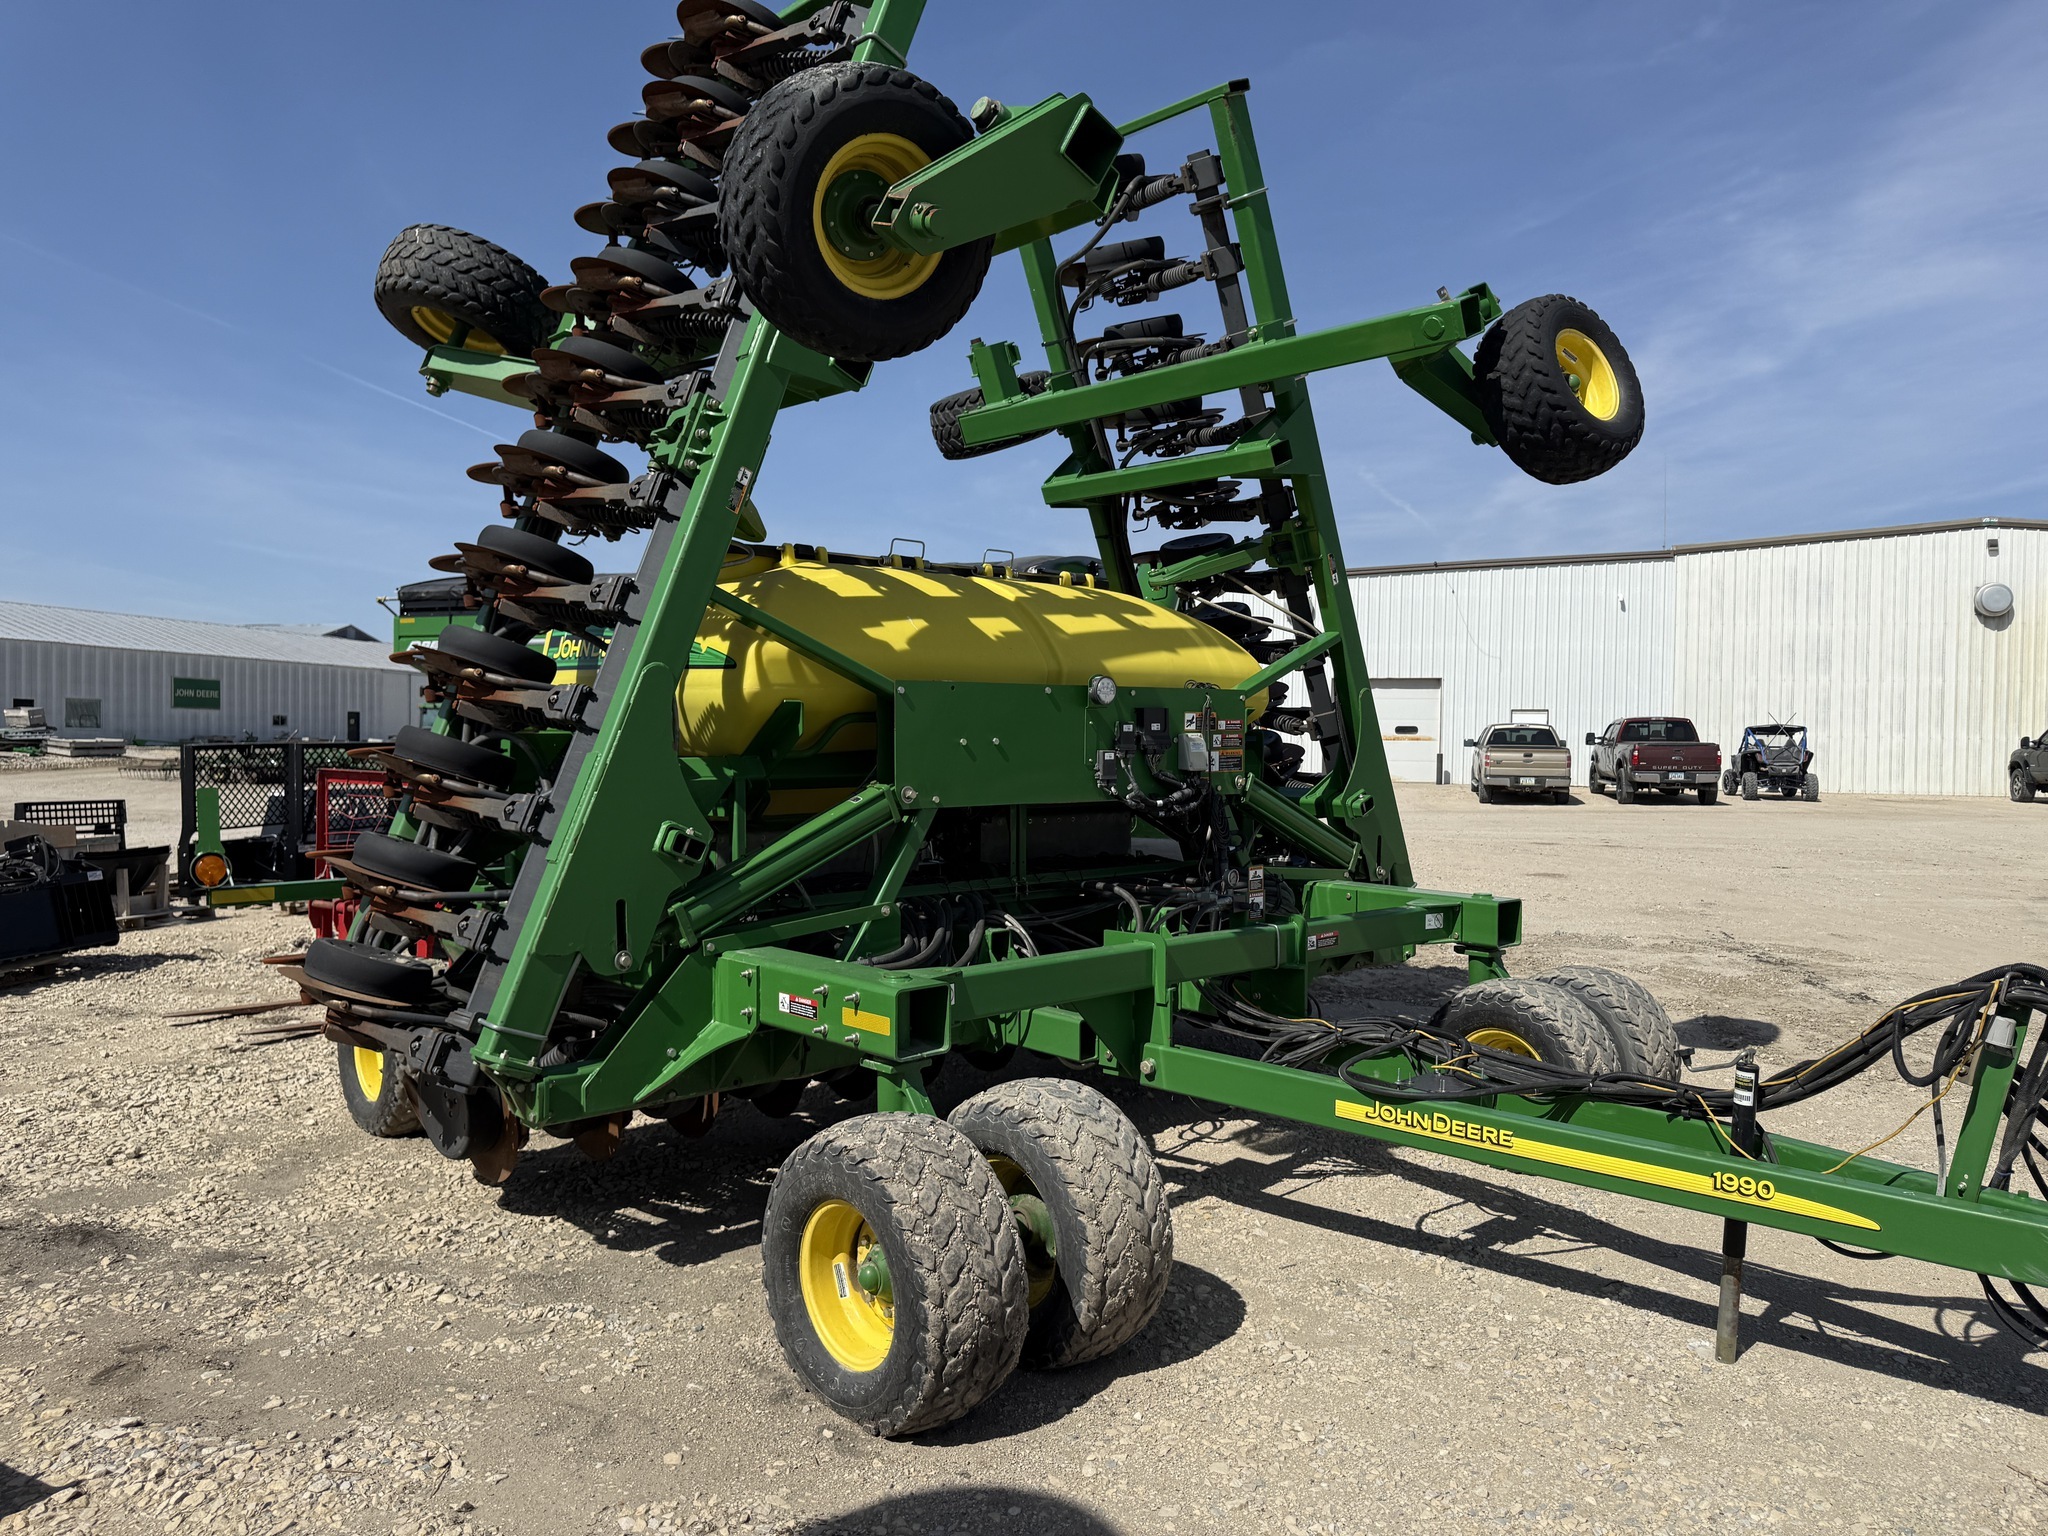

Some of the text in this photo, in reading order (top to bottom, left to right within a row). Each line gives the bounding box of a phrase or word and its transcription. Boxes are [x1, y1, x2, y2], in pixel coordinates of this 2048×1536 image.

[553, 635, 591, 659] JOHN
[175, 688, 219, 698] JOHN DEERE
[1366, 1100, 1514, 1147] JOHN DEERE
[1711, 1171, 1775, 1200] 1990
